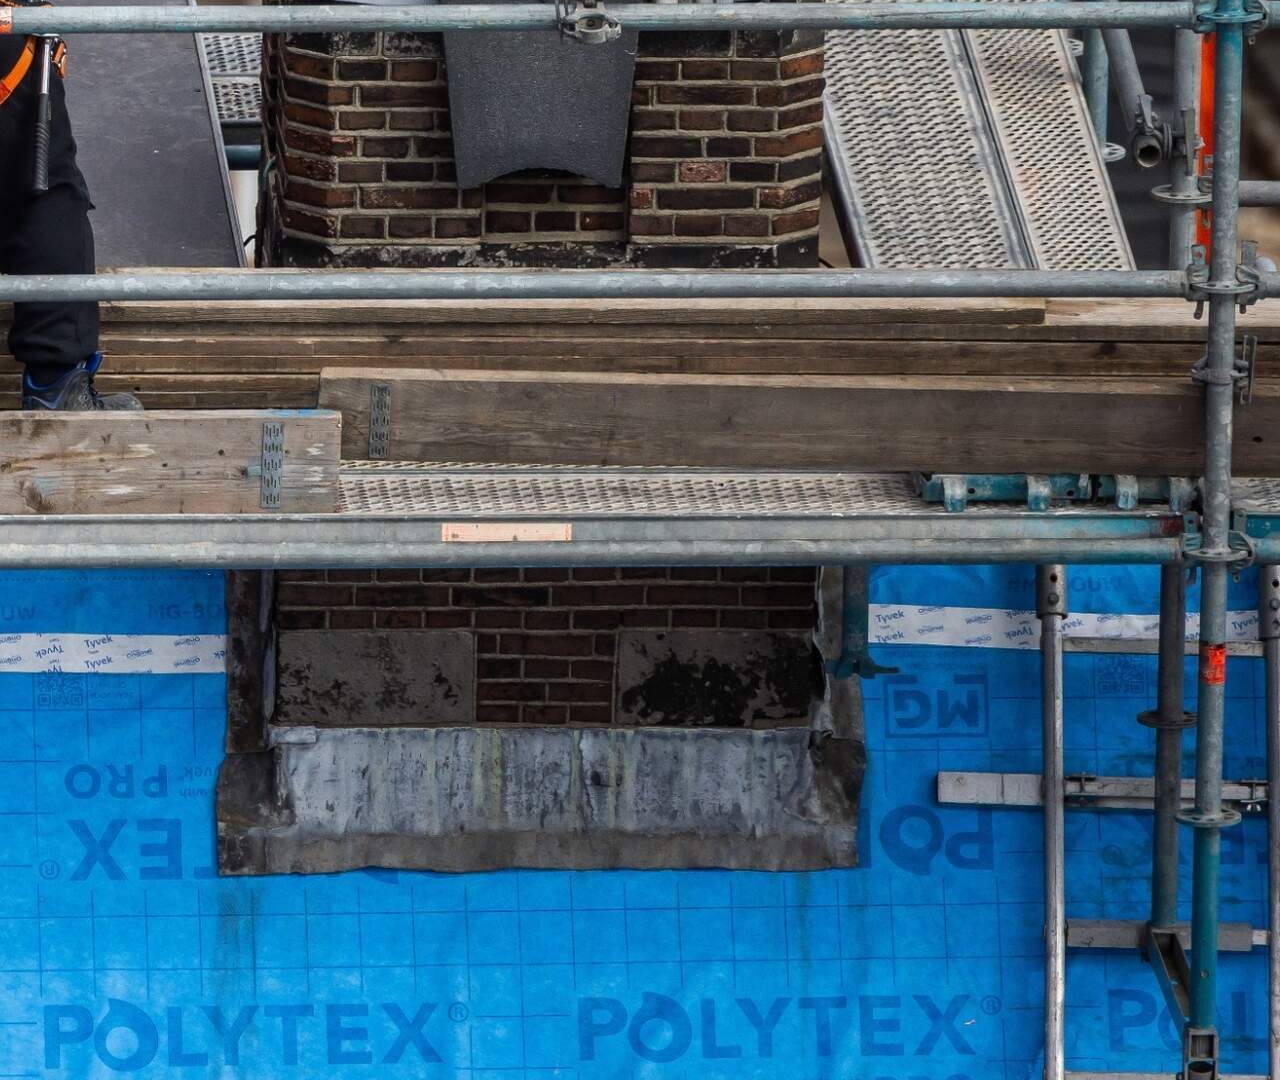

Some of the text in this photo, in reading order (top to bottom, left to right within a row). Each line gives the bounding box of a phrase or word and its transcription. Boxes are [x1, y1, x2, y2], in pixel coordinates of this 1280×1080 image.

[875, 610, 904, 624] Tyvek
[1061, 618, 1084, 632] yvek
[875, 631, 904, 644] Tyvek
[1005, 626, 1033, 640] Tyvek
[84, 635, 113, 650] Tyvek
[35, 644, 64, 659] Tyvek
[84, 655, 113, 670] Tyvek
[893, 688, 980, 729] MG
[64, 764, 168, 800] PRO
